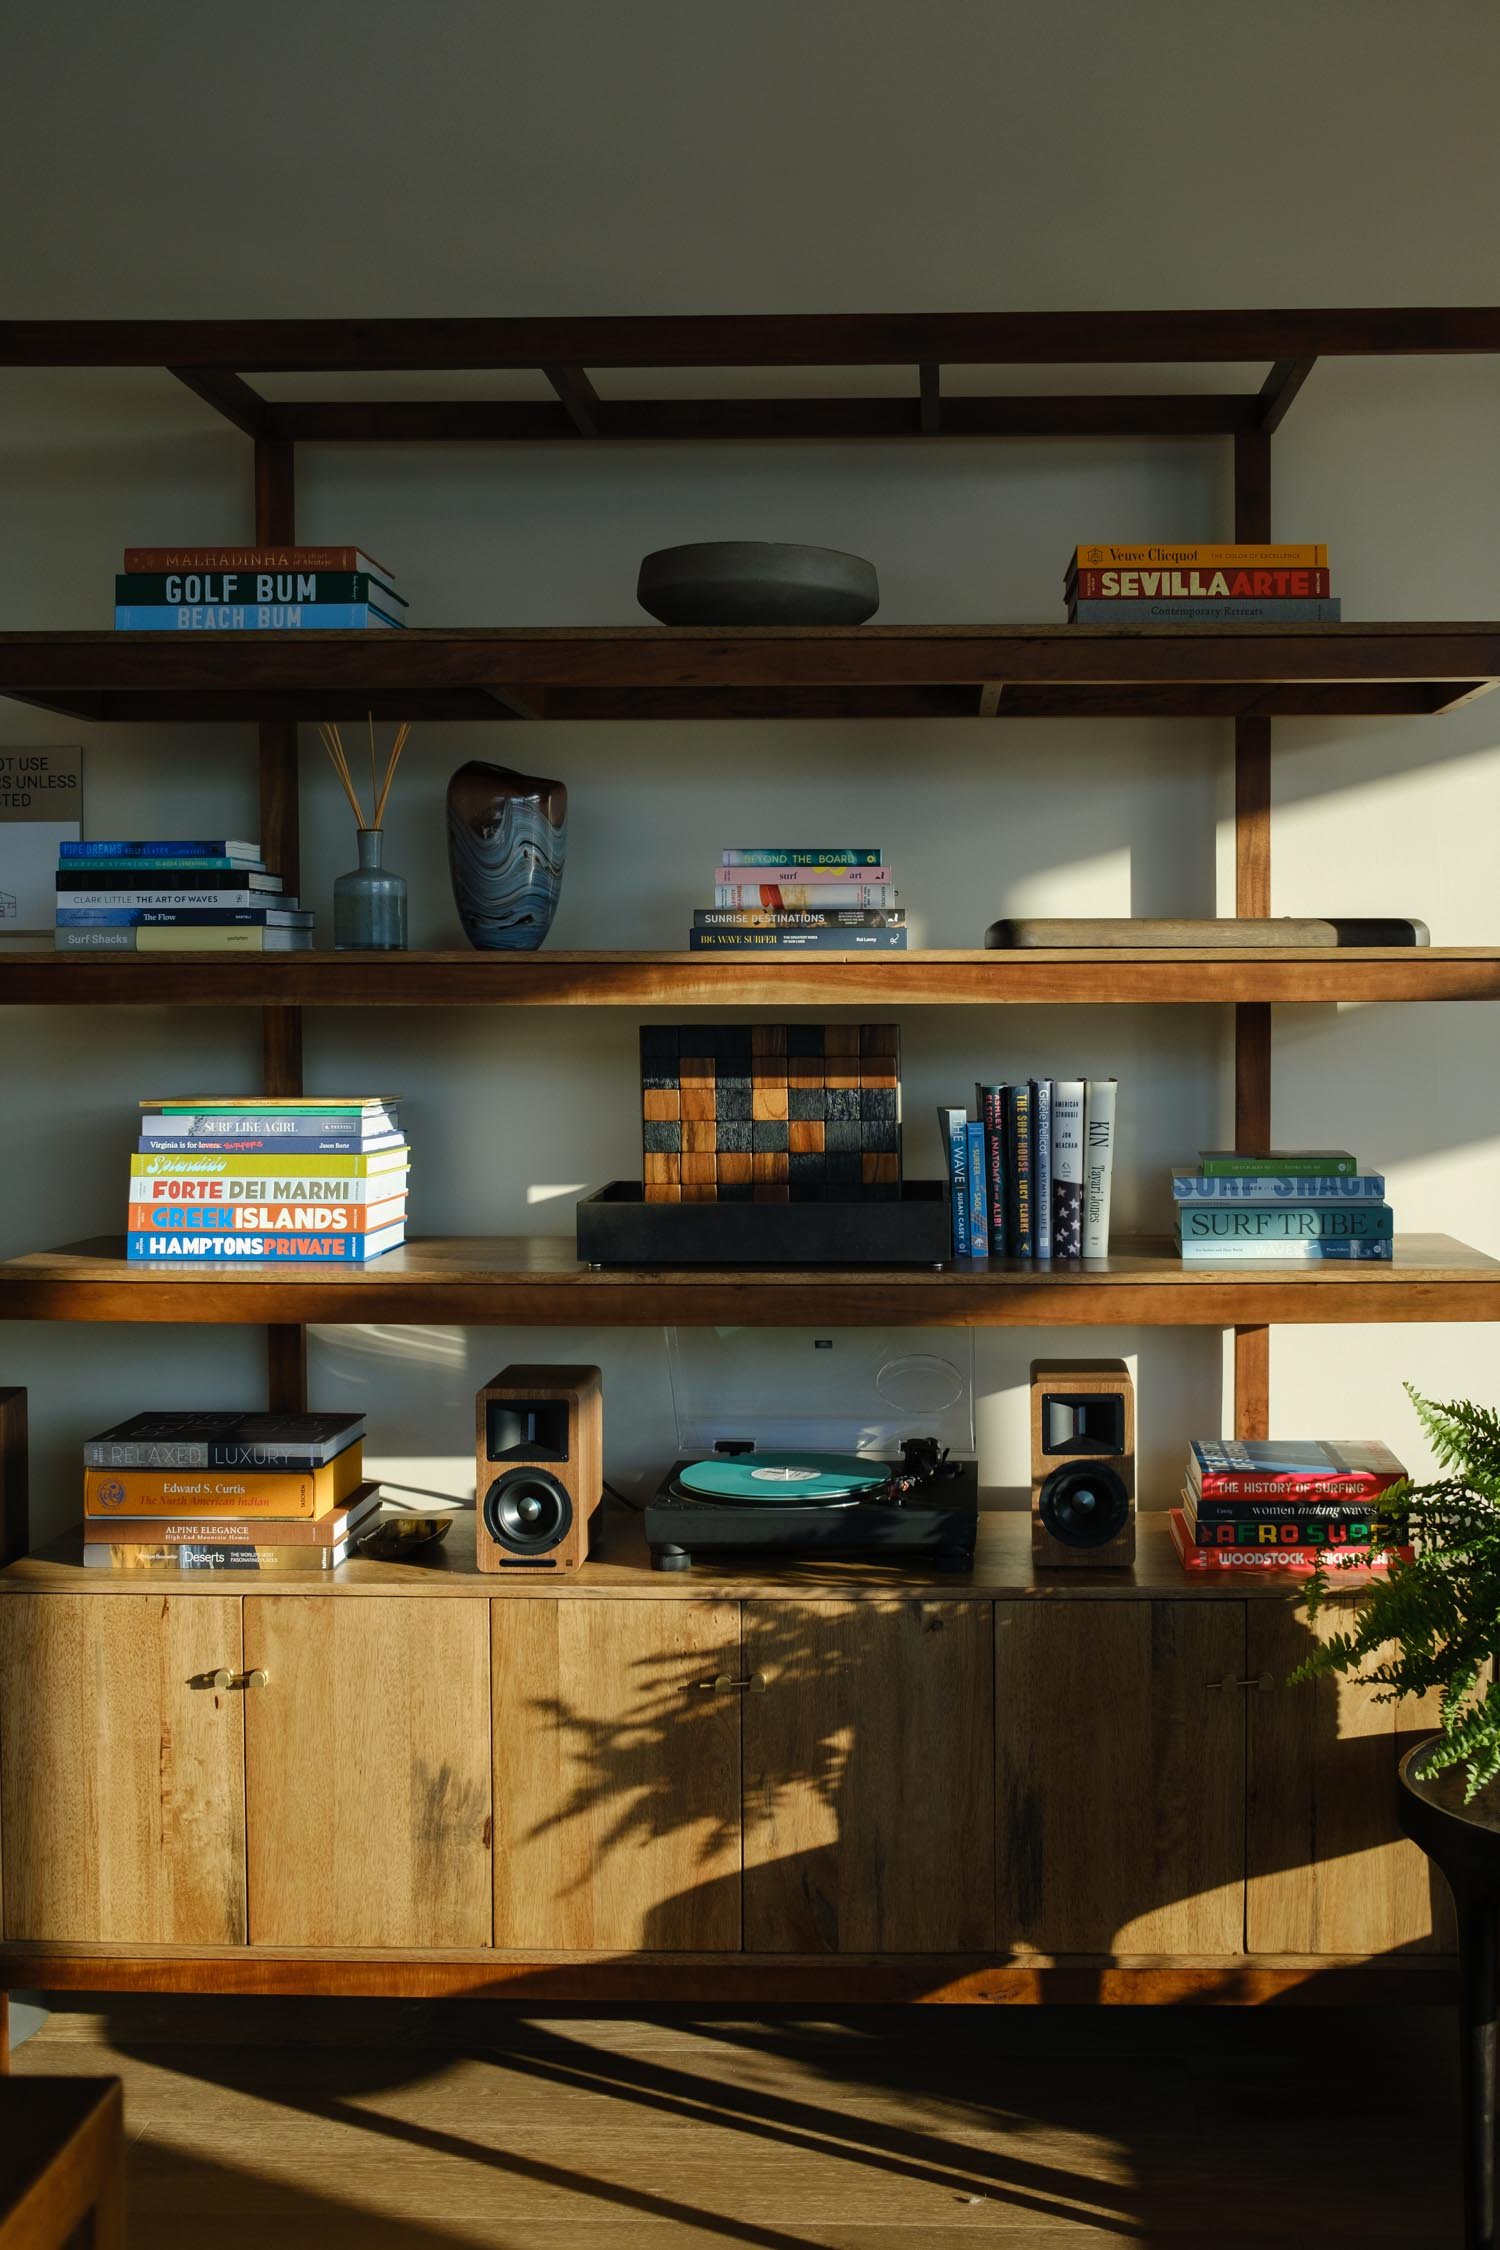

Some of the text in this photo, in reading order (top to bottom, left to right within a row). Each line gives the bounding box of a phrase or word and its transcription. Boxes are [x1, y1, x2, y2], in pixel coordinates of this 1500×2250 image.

[165, 552, 289, 568] MALHADINHA
[1110, 547, 1198, 563] Veuve Clicquot
[165, 573, 317, 603] GOLF BUM
[177, 605, 301, 629] BEACH BUM
[1151, 606, 1264, 618] Contemporary Retreats
[19, 757, 49, 771] USE
[16, 774, 77, 789] UNLESS
[0, 793, 32, 808] TED
[86, 843, 122, 856] DREAMS
[744, 854, 855, 864] BEYOND THE BOARD
[779, 871, 799, 880] surf
[73, 896, 102, 904] CLARK
[104, 896, 132, 904] LITTLE
[188, 895, 218, 903] WAVES
[143, 913, 176, 921] The Flow
[704, 913, 825, 923] SUNRISE DESTINATIONS
[68, 933, 128, 945] Surf Shacks
[701, 935, 777, 944] BIG WAVE SURFER
[994, 1094, 1003, 1130] ASHLEY
[1038, 1089, 1049, 1120] Gisèle
[985, 1094, 993, 1131] ELSTON
[205, 1121, 299, 1133] SURF LIKE A GIRL
[1088, 1120, 1110, 1148] KIN
[150, 1140, 178, 1150] Virginia
[180, 1141, 186, 1149] is
[187, 1141, 197, 1149] for
[1038, 1121, 1049, 1157] Pelicot
[991, 1135, 1001, 1185] ANATOMY
[1016, 1094, 1030, 1233] THE SURF HOUSE LUCY CLARKE
[952, 1118, 966, 1240] THE WAVE SUSAN CASEY
[1040, 1171, 1048, 1197] HYMN
[1088, 1165, 1106, 1196] Tayari
[152, 1181, 223, 1199] FORTE
[229, 1181, 267, 1199] DEI
[273, 1181, 350, 1200] MARMI
[1040, 1199, 1048, 1212] TO
[1089, 1196, 1103, 1223] Jones
[993, 1202, 1003, 1228] ALIBI
[1040, 1214, 1048, 1232] LIFE
[1191, 1213, 1368, 1236] SURF TRIBE
[111, 1447, 200, 1464] RELAXED
[215, 1447, 290, 1465] LUXURY
[163, 1483, 246, 1494] Edward S. Curtis
[1217, 1482, 1365, 1493] THE HISTORY OF SURFING
[140, 1496, 270, 1507] The North American Indian
[1252, 1504, 1377, 1518] women making waves
[165, 1526, 249, 1534] ALPINE ELEGANCE
[1216, 1525, 1299, 1543] AFRO
[184, 1551, 225, 1563] Deserts
[1218, 1552, 1305, 1565] WOODSTOCK
